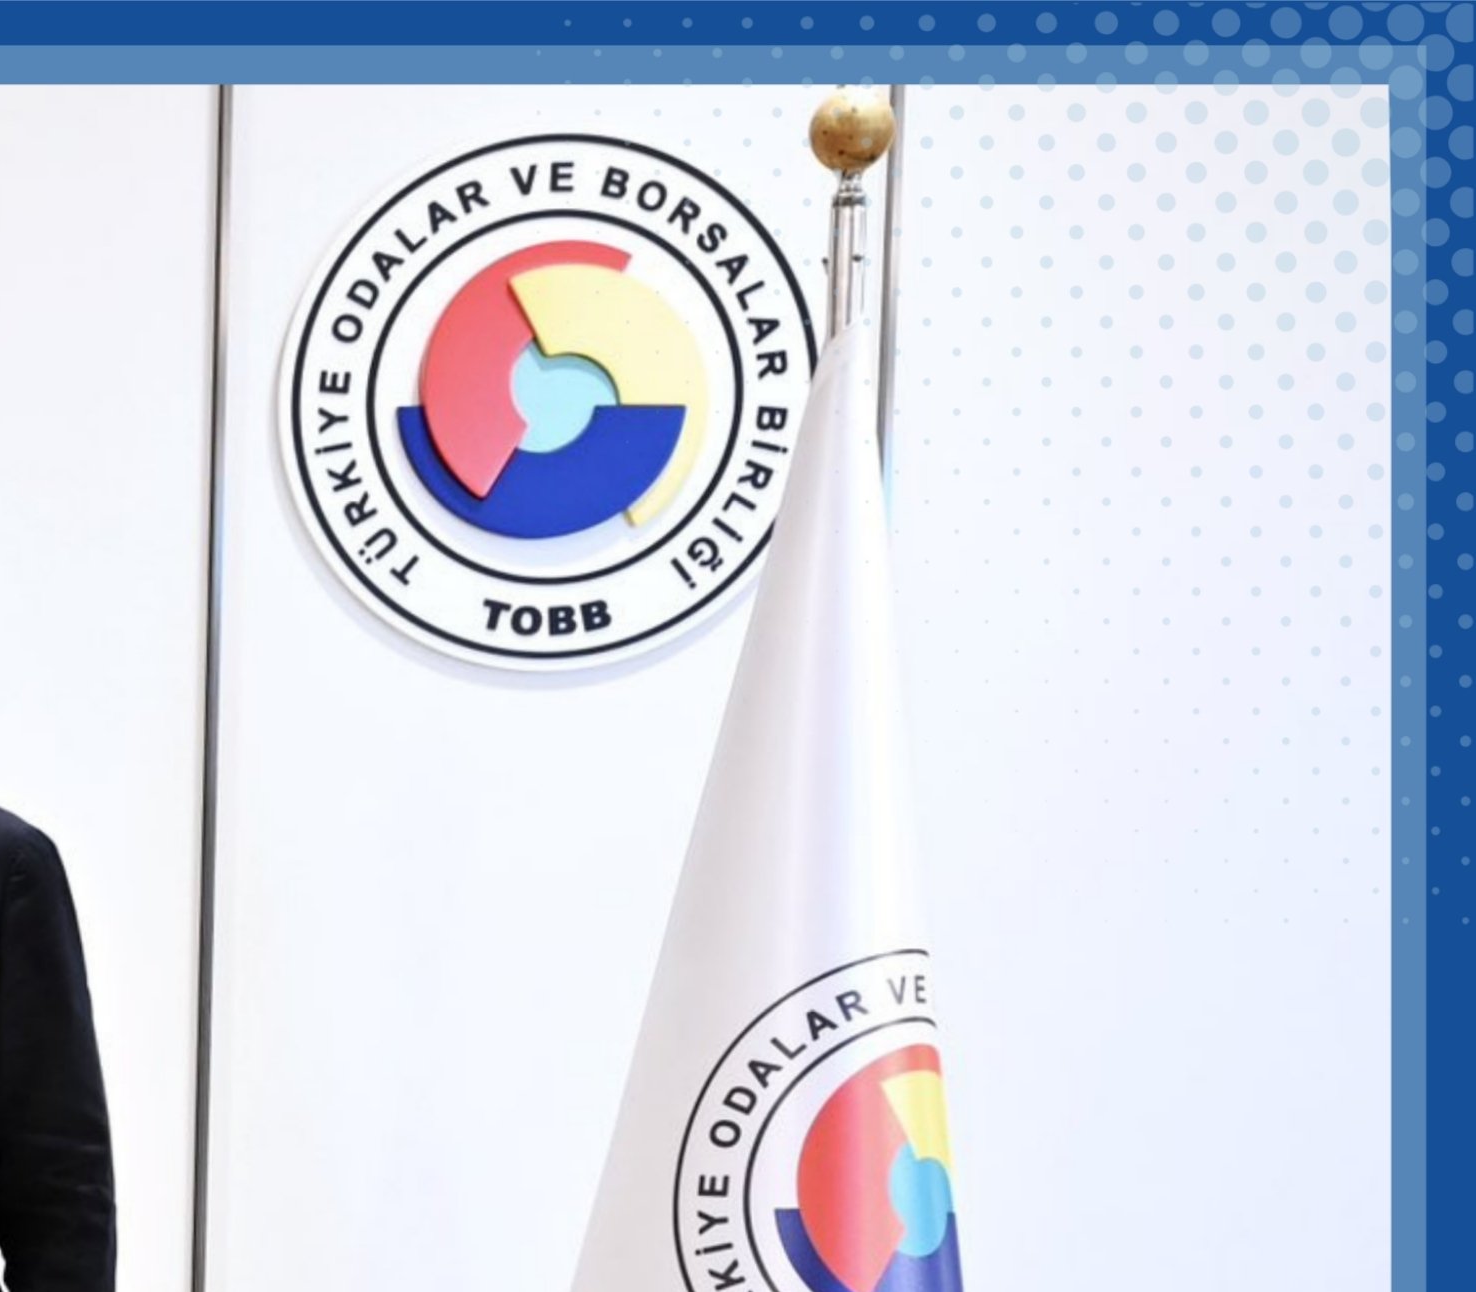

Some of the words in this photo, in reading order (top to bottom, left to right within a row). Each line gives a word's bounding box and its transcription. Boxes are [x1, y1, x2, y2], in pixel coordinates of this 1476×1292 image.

[331, 180, 489, 344] ODALAR
[510, 162, 574, 196] VE
[601, 167, 787, 380] BORSALAR
[315, 370, 420, 586] TÜRKİYE
[670, 406, 787, 588] BİRLİĞİ
[483, 599, 611, 635] TOBB
[709, 990, 868, 1148] ODALAR
[887, 975, 927, 1004] VE
